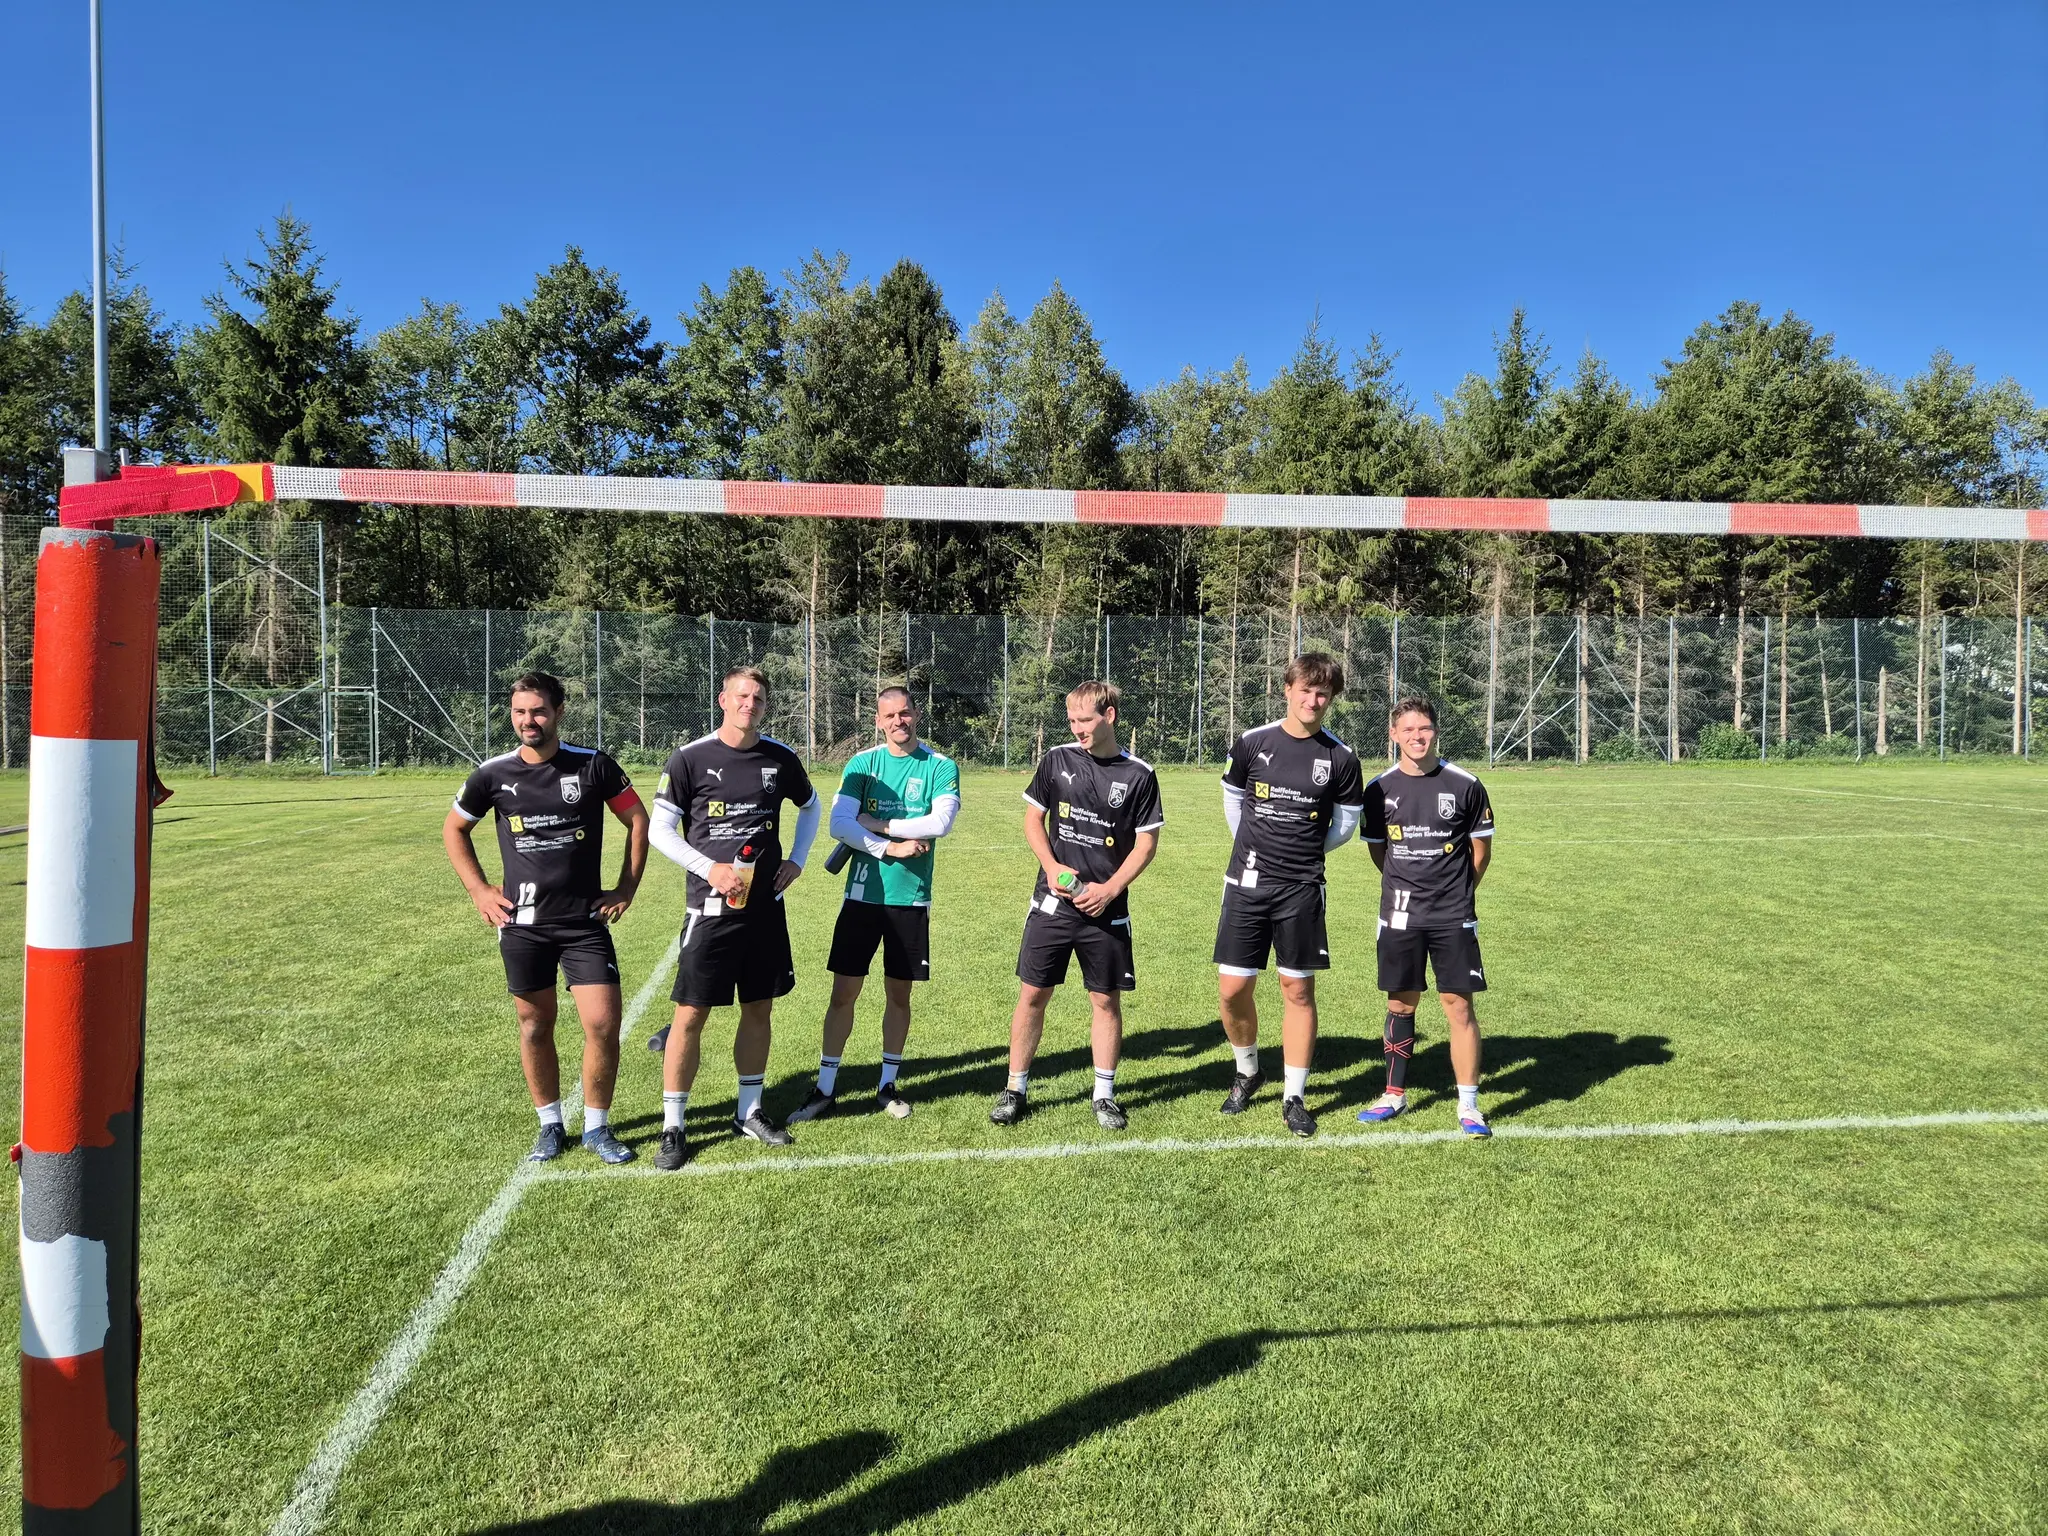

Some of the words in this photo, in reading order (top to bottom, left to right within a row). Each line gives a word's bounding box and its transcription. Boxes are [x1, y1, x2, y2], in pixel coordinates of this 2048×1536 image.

[1270, 786, 1301, 796] Raiffeisen
[523, 815, 558, 823] Raiffeisen
[1090, 817, 1116, 828] Kirchdof
[523, 821, 548, 829] Region
[1393, 848, 1444, 856] SGNAGE
[1246, 850, 1257, 869] 5
[853, 861, 869, 882] 16
[517, 882, 537, 906] 12
[1394, 889, 1411, 911] 17
